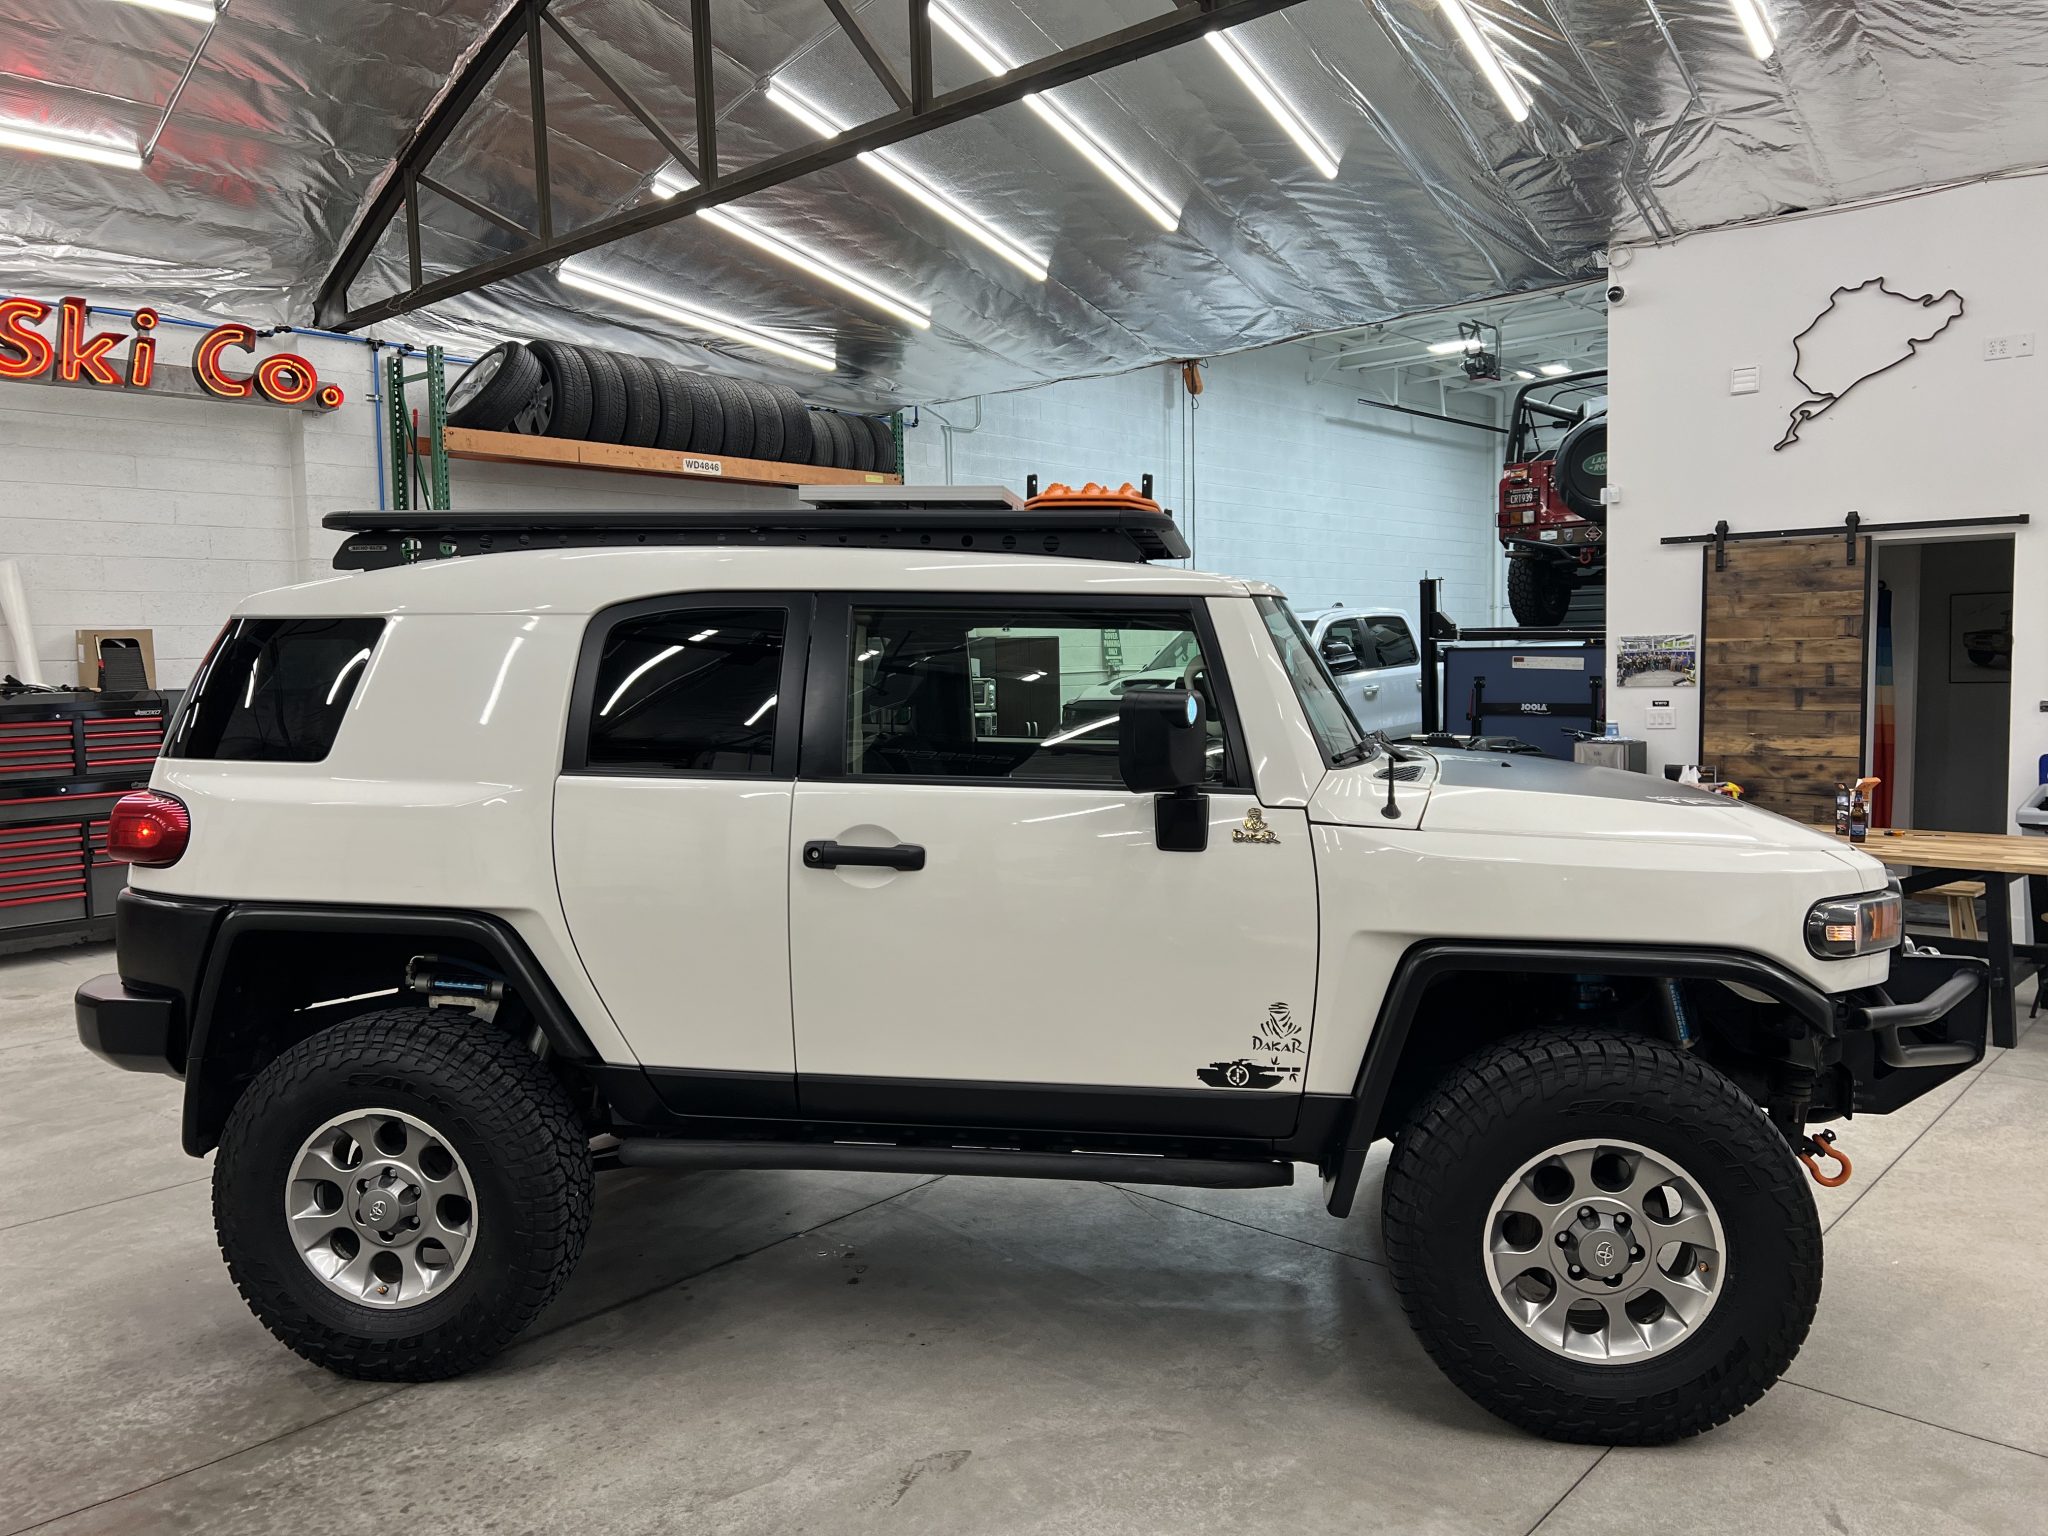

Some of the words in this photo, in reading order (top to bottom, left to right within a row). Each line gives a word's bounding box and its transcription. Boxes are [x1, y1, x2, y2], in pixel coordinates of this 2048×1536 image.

[0, 297, 159, 388] Ski
[192, 323, 344, 408] Co.
[685, 459, 719, 471] WD4846
[1520, 703, 1548, 711] JOOLA
[1252, 1035, 1305, 1054] DAKAR
